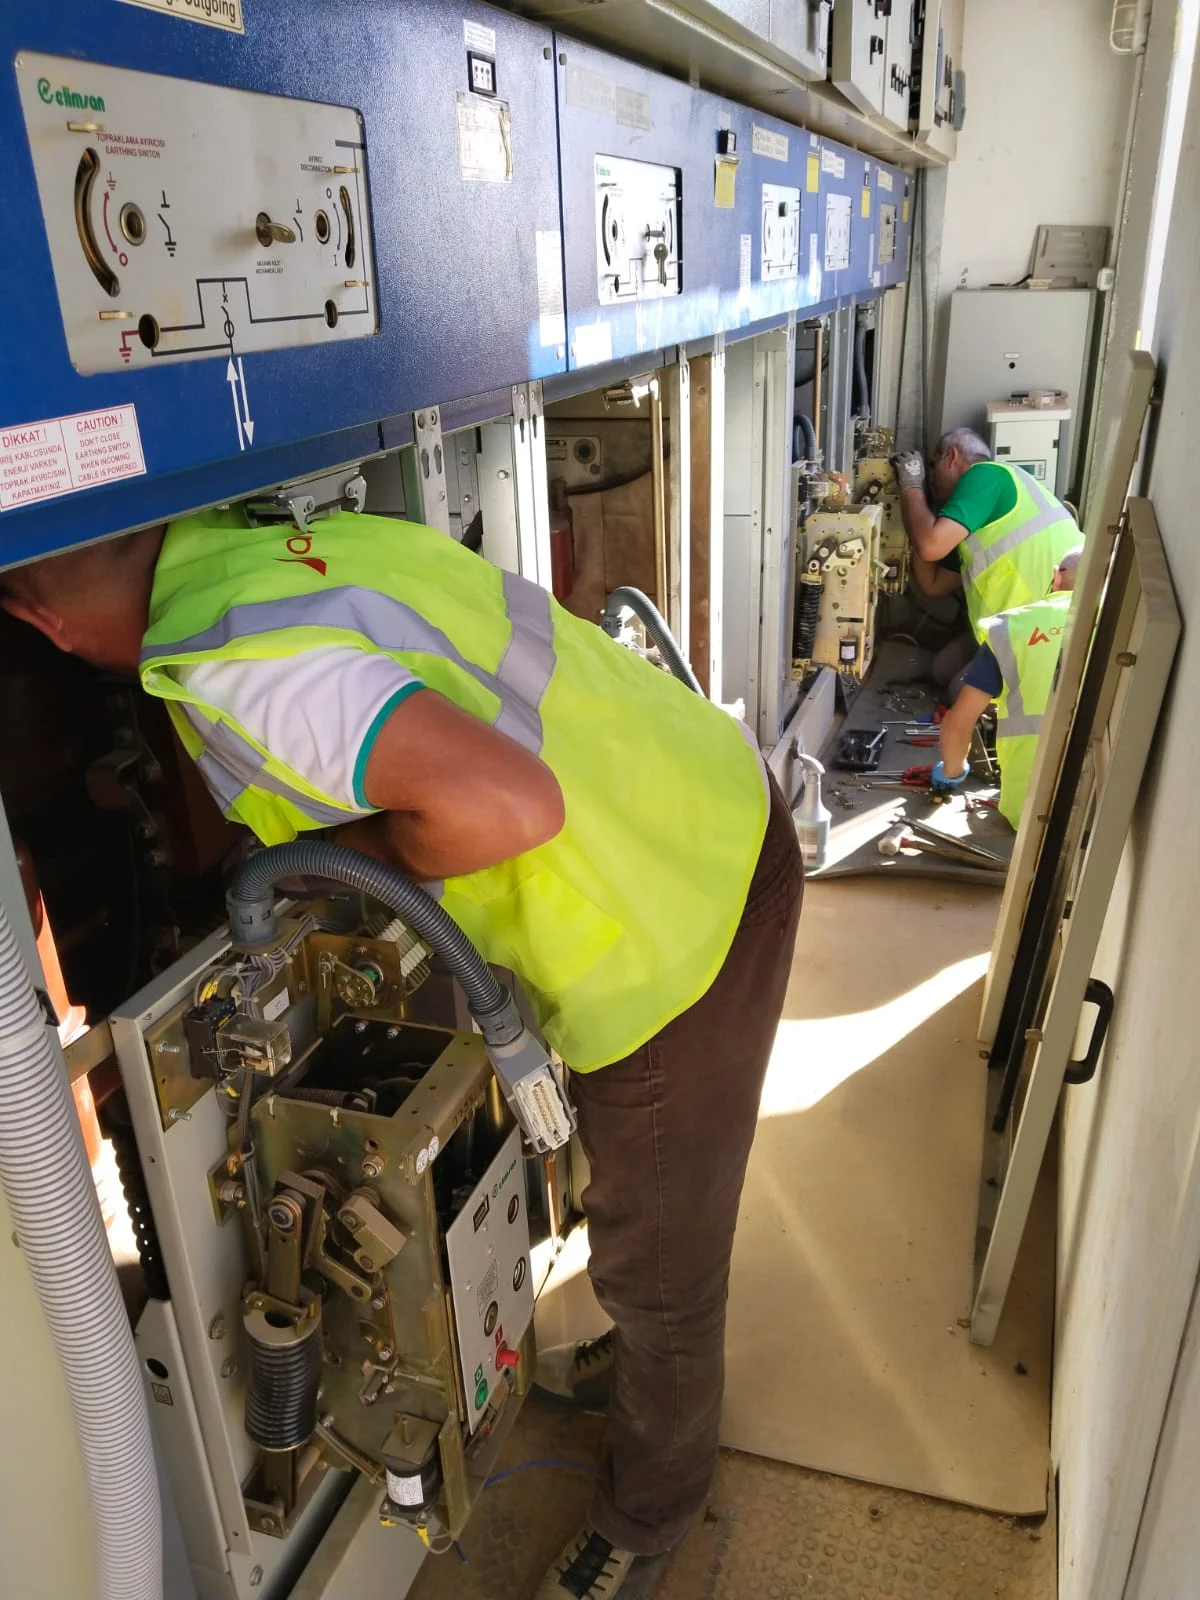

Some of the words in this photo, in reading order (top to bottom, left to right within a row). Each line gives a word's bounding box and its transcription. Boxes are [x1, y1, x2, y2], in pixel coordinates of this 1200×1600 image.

[105, 145, 137, 157] EARTHING
[138, 148, 160, 159] SWITCH
[76, 415, 118, 432] CAUTION
[80, 436, 98, 448] DON'T
[100, 432, 121, 443] CLOSE
[0, 453, 14, 464] RİŞ
[15, 444, 62, 461] KABLOSUNDA
[75, 446, 107, 460] EARTHING
[108, 441, 131, 453] SWITCH
[30, 457, 58, 471] VARKEN
[80, 460, 100, 470] WHEN
[100, 452, 130, 466] INCOMING
[77, 471, 99, 482] CABLE
[100, 469, 106, 477] IS
[0, 477, 29, 491] TOPRAK
